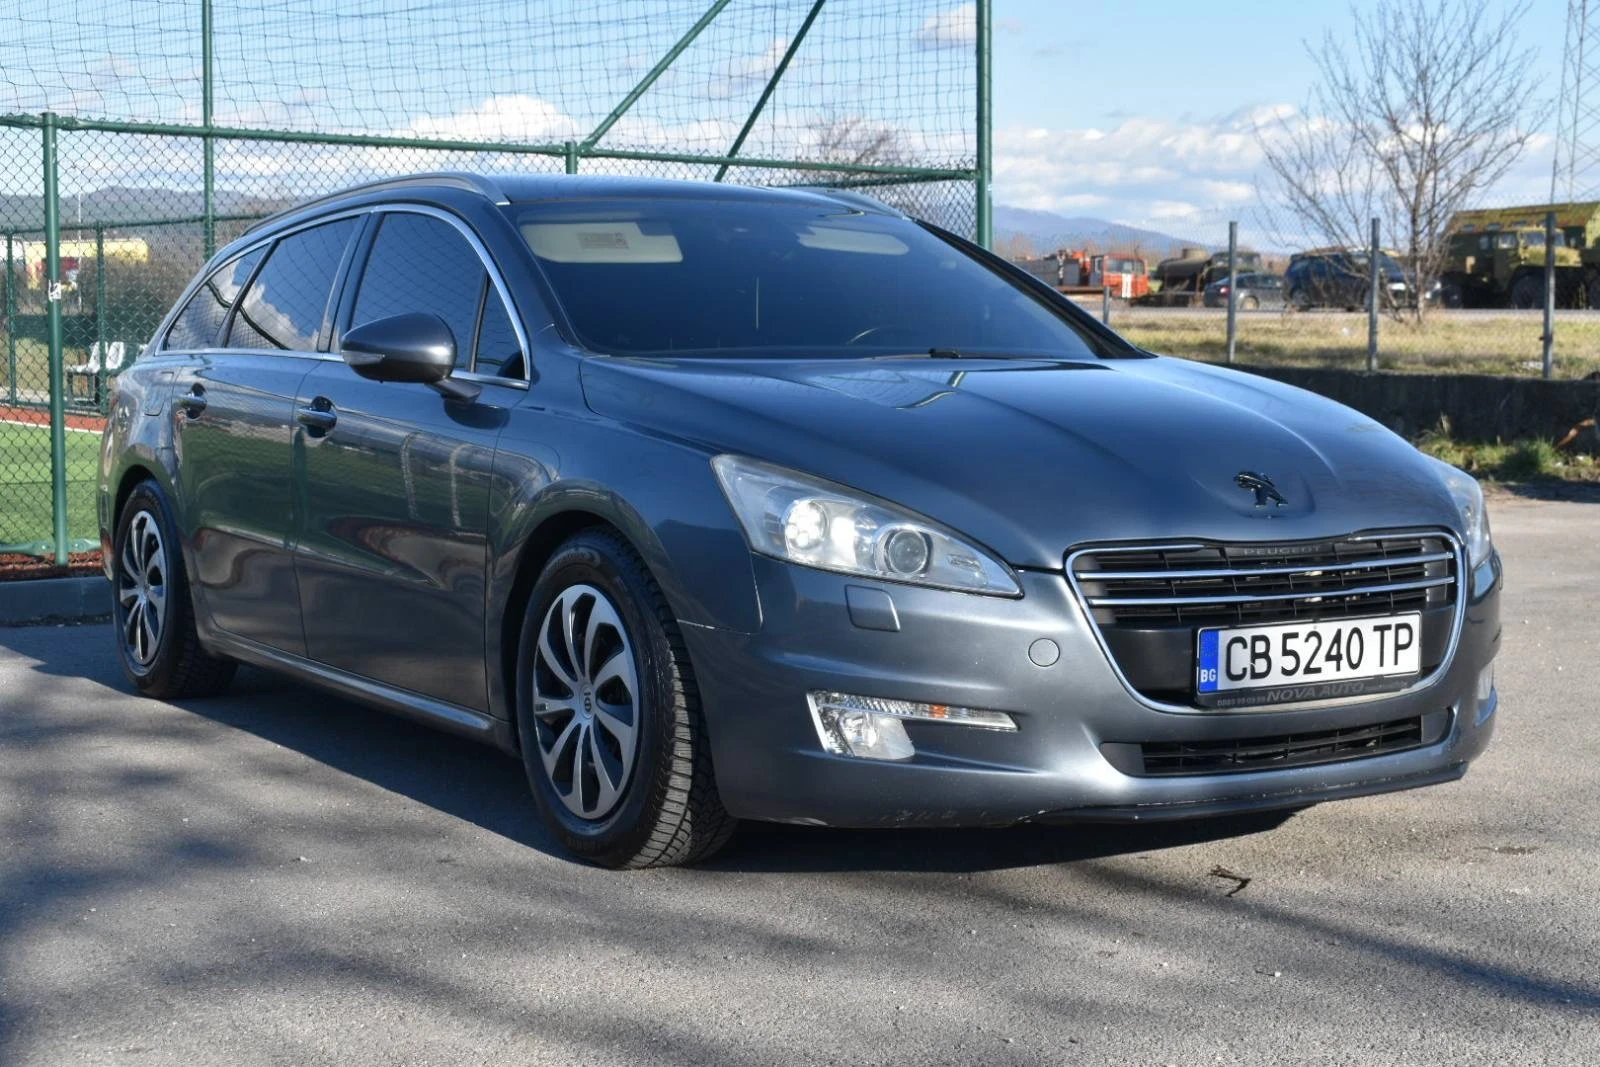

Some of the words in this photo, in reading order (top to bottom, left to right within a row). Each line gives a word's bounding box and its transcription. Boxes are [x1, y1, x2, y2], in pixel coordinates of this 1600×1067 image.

[1225, 635, 1273, 682] CB
[1280, 626, 1364, 677] 5240
[1373, 622, 1414, 668] TP
[1200, 668, 1217, 683] BG
[1266, 686, 1316, 702] NOVA
[1320, 681, 1365, 697] AUTO
